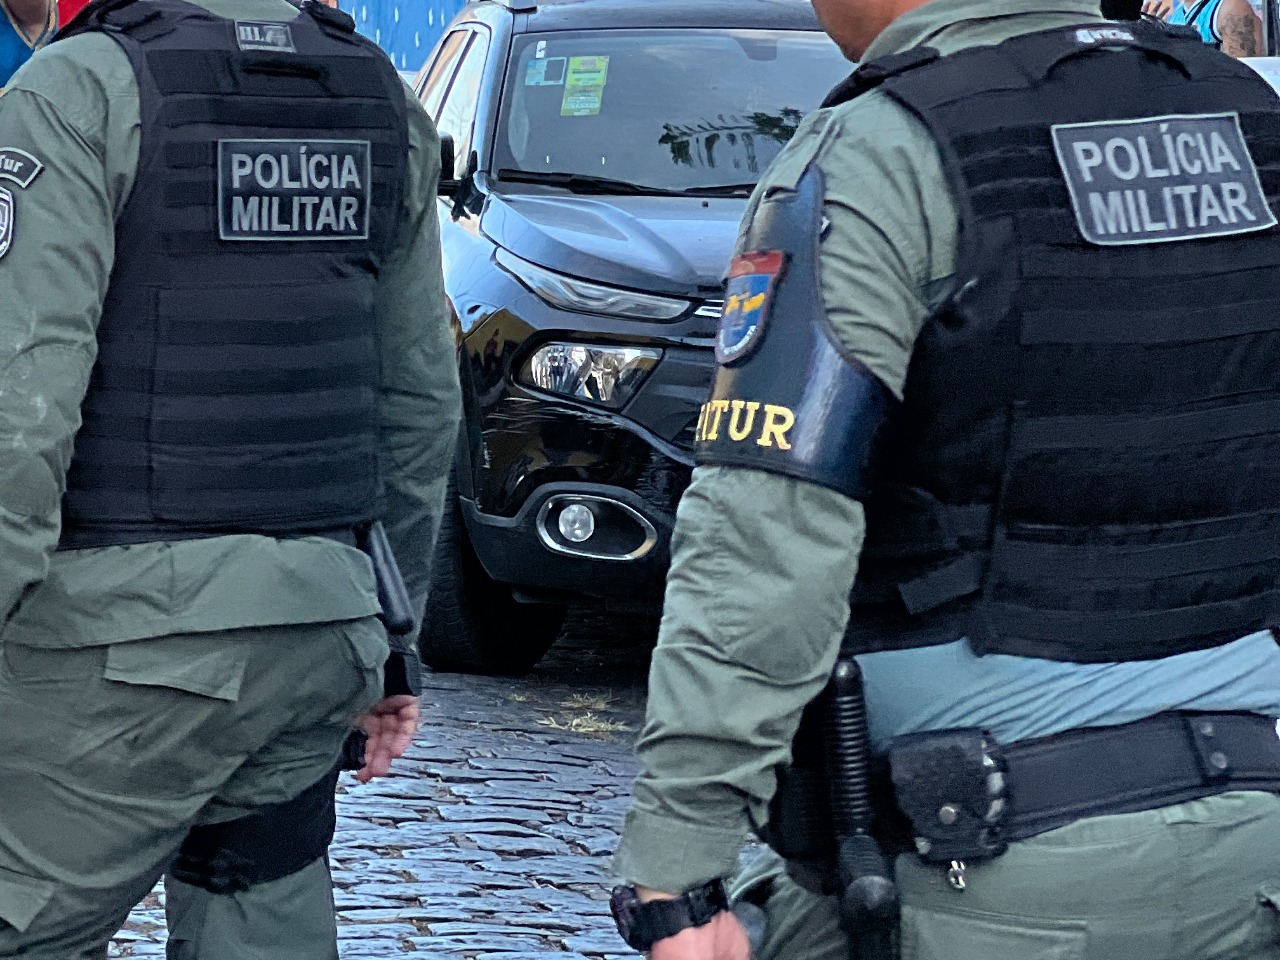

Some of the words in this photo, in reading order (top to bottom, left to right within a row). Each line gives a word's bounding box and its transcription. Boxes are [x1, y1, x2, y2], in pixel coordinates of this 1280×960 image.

[231, 146, 362, 189] POLÍCIA
[1073, 124, 1241, 182] POLÍCIA
[232, 196, 358, 232] MILITAR
[1089, 182, 1256, 235] MILITAR
